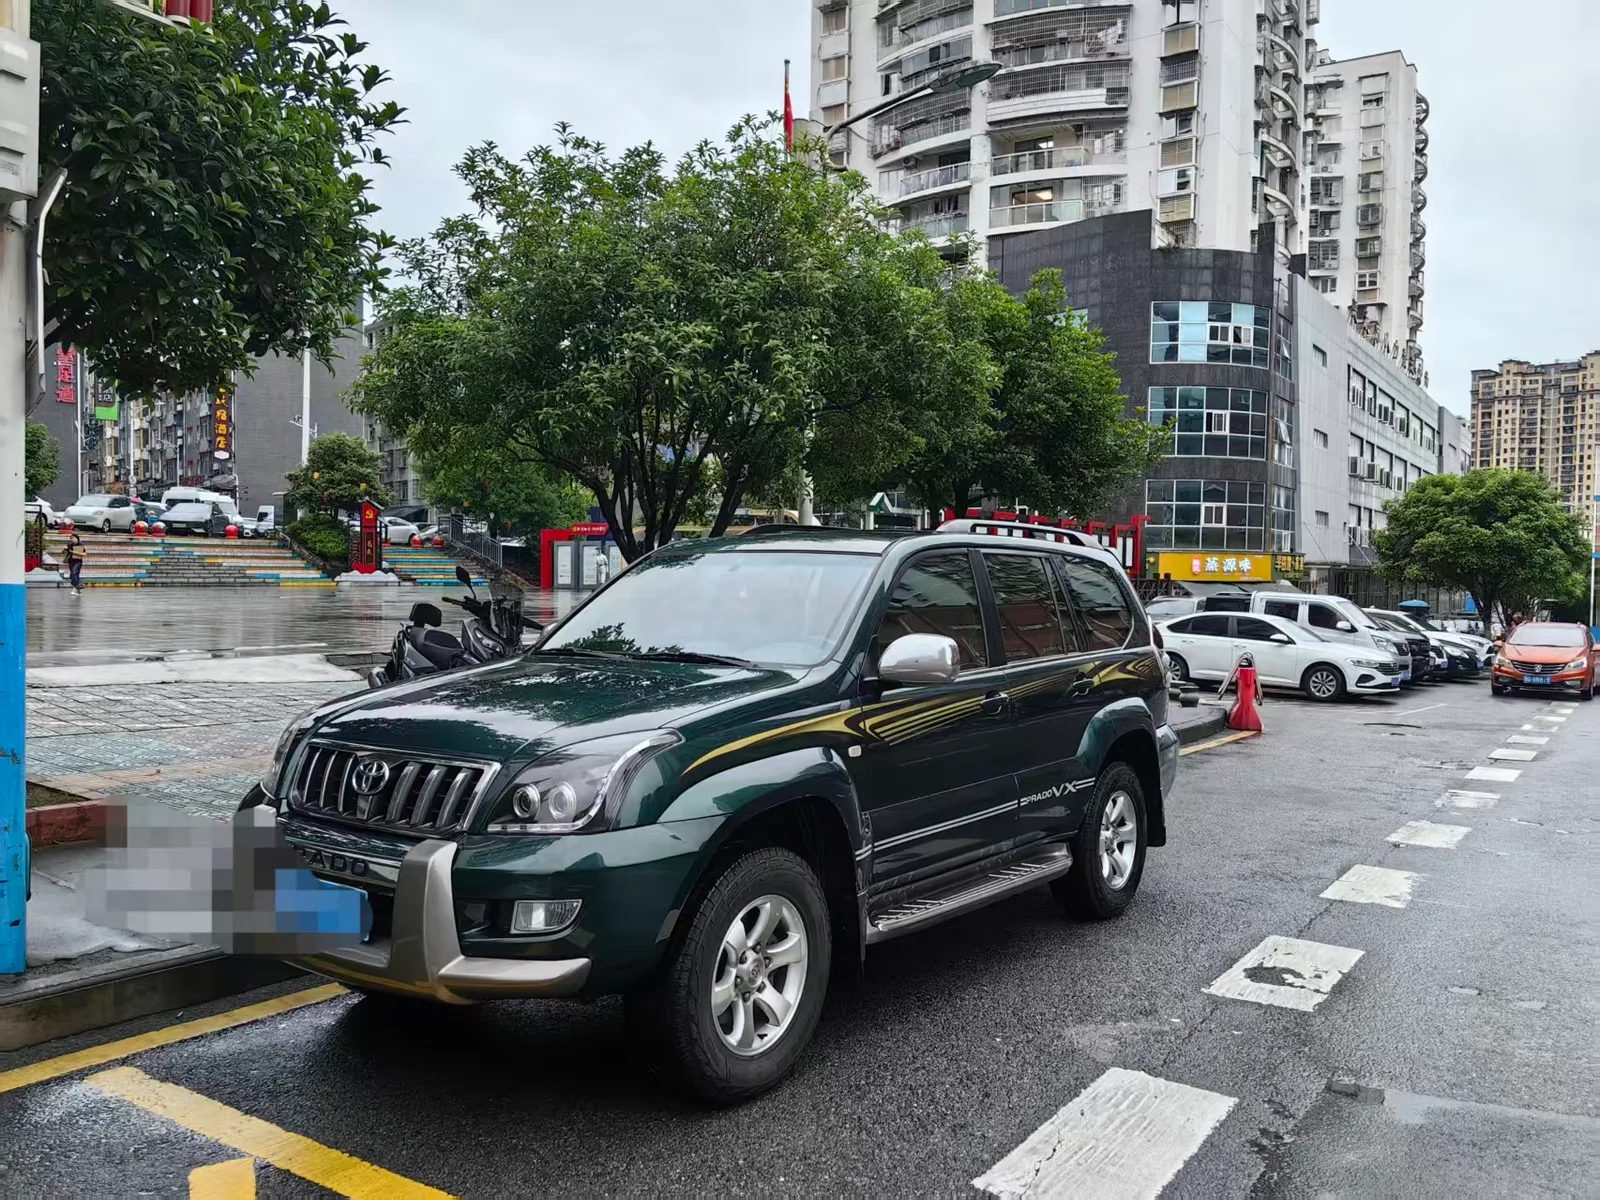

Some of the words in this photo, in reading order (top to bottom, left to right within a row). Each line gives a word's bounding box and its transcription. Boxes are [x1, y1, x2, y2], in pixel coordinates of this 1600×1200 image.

[1205, 556, 1252, 572] 蒸源味
[1052, 780, 1077, 797] VX
